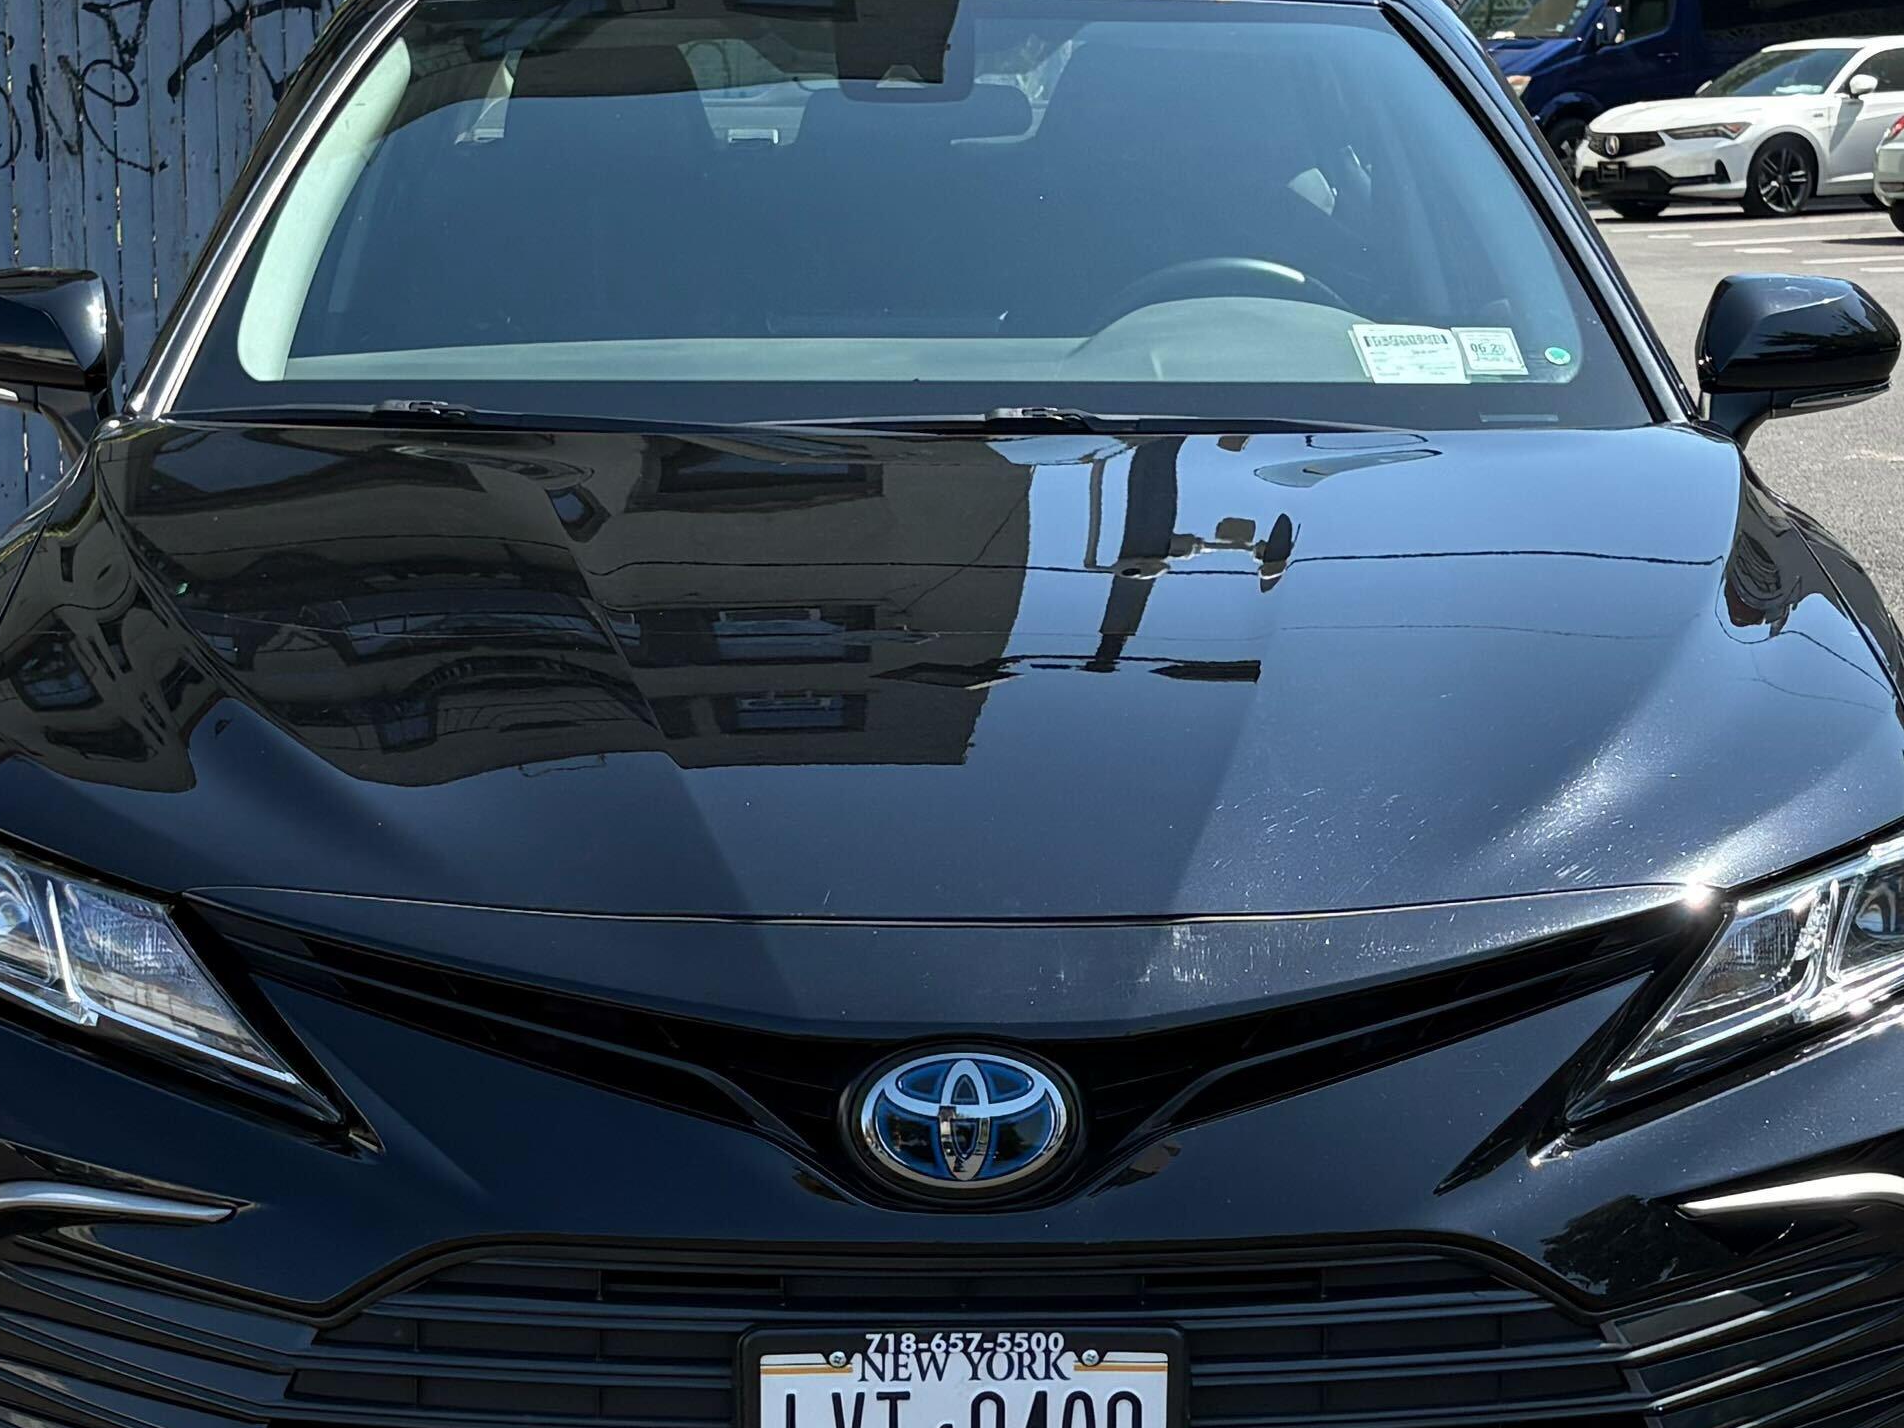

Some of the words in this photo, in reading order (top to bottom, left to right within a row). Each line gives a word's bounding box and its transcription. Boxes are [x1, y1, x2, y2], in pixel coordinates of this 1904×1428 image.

[865, 1332, 1065, 1354] 718-657-5500
[858, 1352, 952, 1382] NEW
[967, 1351, 1071, 1382] YORK
